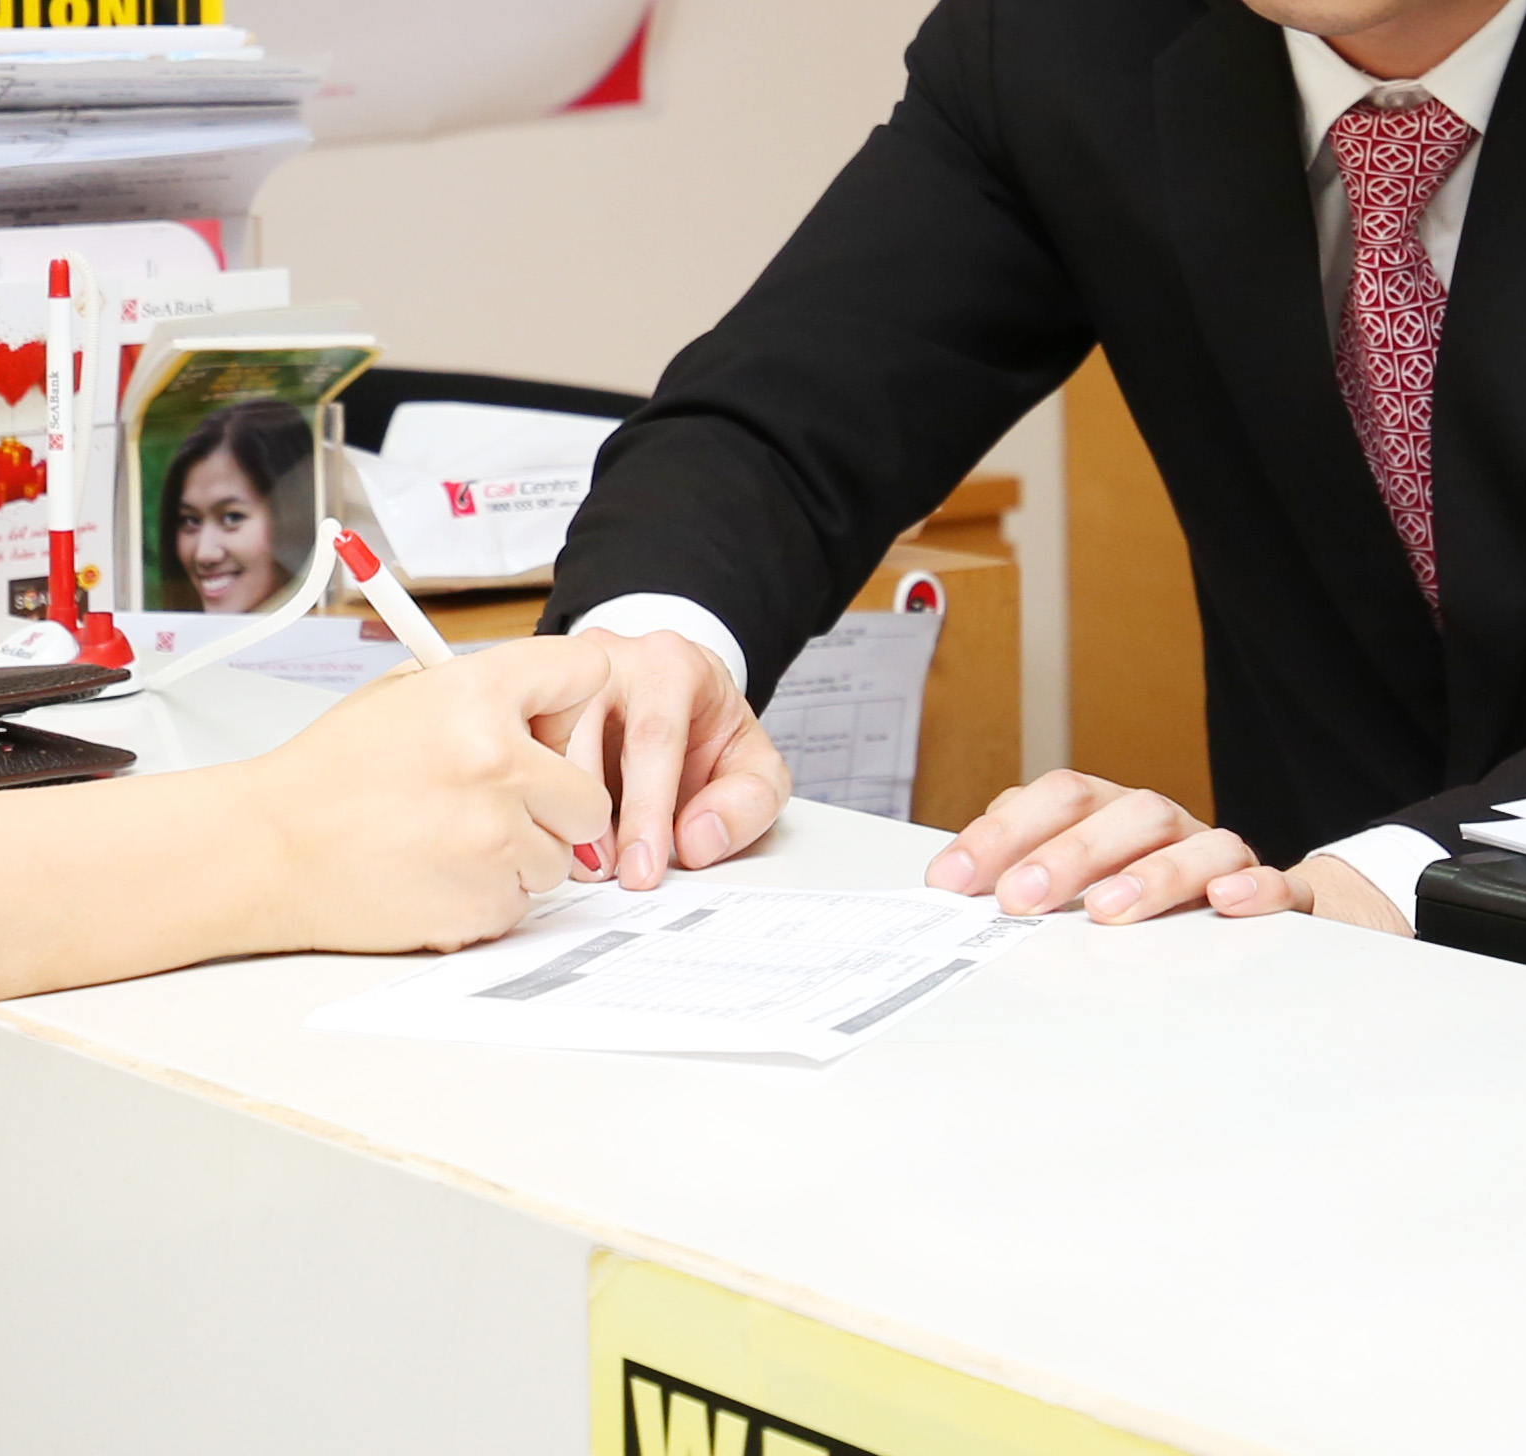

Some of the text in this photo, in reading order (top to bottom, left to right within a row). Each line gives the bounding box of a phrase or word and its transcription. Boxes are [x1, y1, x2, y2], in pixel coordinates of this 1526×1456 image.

[142, 298, 214, 319] SeABank
[49, 371, 60, 429] SeABank
[484, 479, 579, 498] Call Centre
